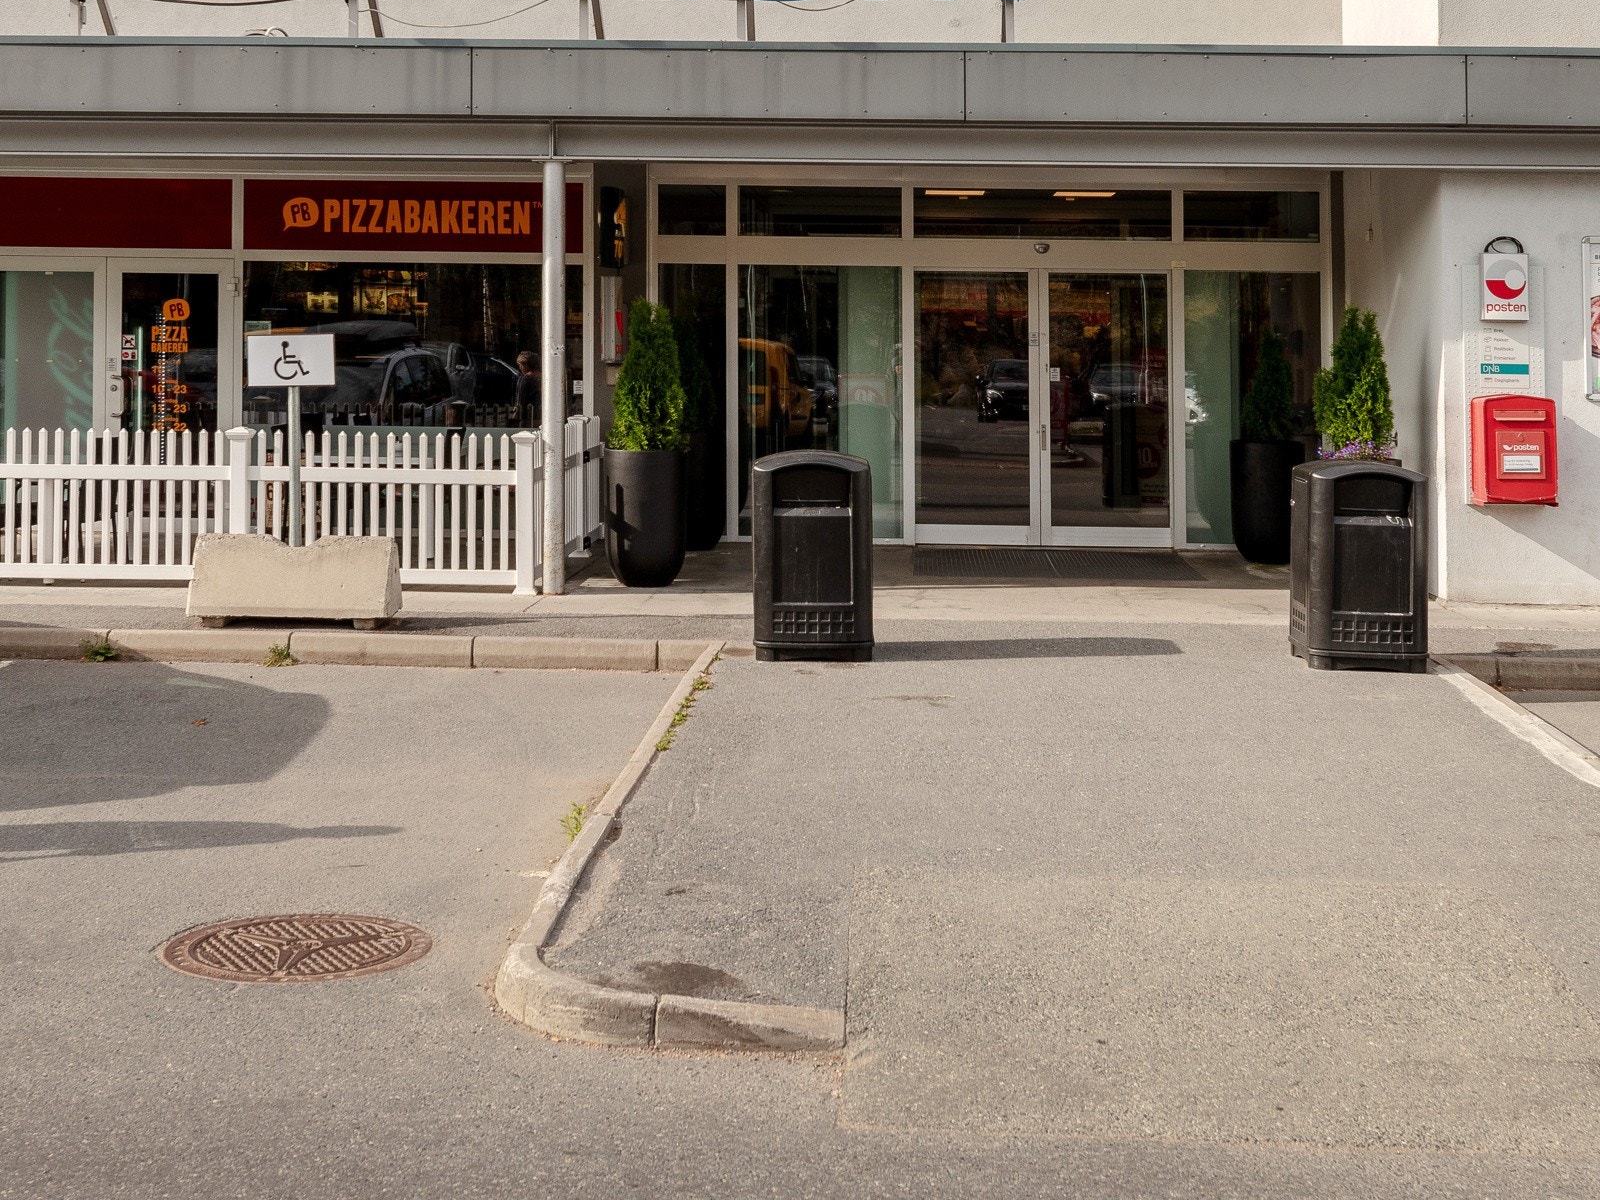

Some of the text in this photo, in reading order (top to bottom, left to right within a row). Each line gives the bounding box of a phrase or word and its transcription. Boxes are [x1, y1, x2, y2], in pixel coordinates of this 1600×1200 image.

[290, 202, 310, 225] PB
[323, 199, 531, 235] PIZZABAKEREN
[169, 302, 185, 318] PB
[1486, 302, 1527, 313] posten
[151, 325, 188, 342] PIZZA
[1482, 363, 1500, 375] DNB
[173, 384, 187, 394] 23
[173, 404, 187, 413] 23
[173, 422, 187, 432] 22
